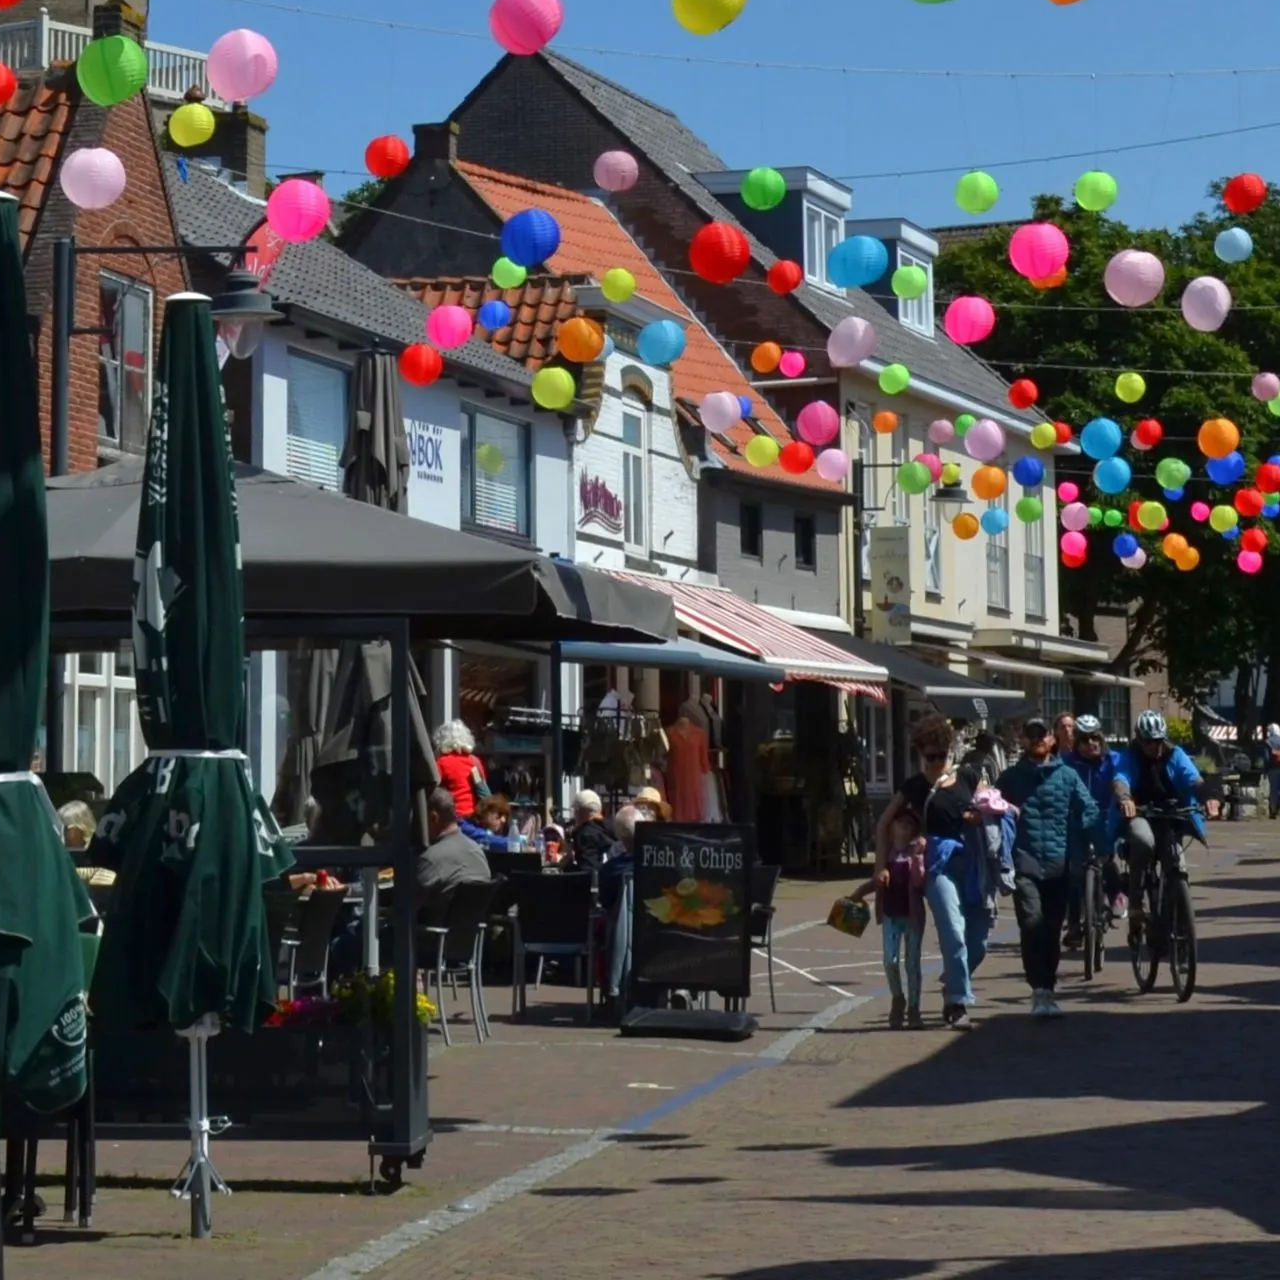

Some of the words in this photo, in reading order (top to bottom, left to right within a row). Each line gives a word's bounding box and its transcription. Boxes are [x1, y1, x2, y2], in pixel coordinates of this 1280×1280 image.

[642, 844, 676, 867] Fish
[680, 846, 694, 867] &
[699, 846, 744, 874] Chips
